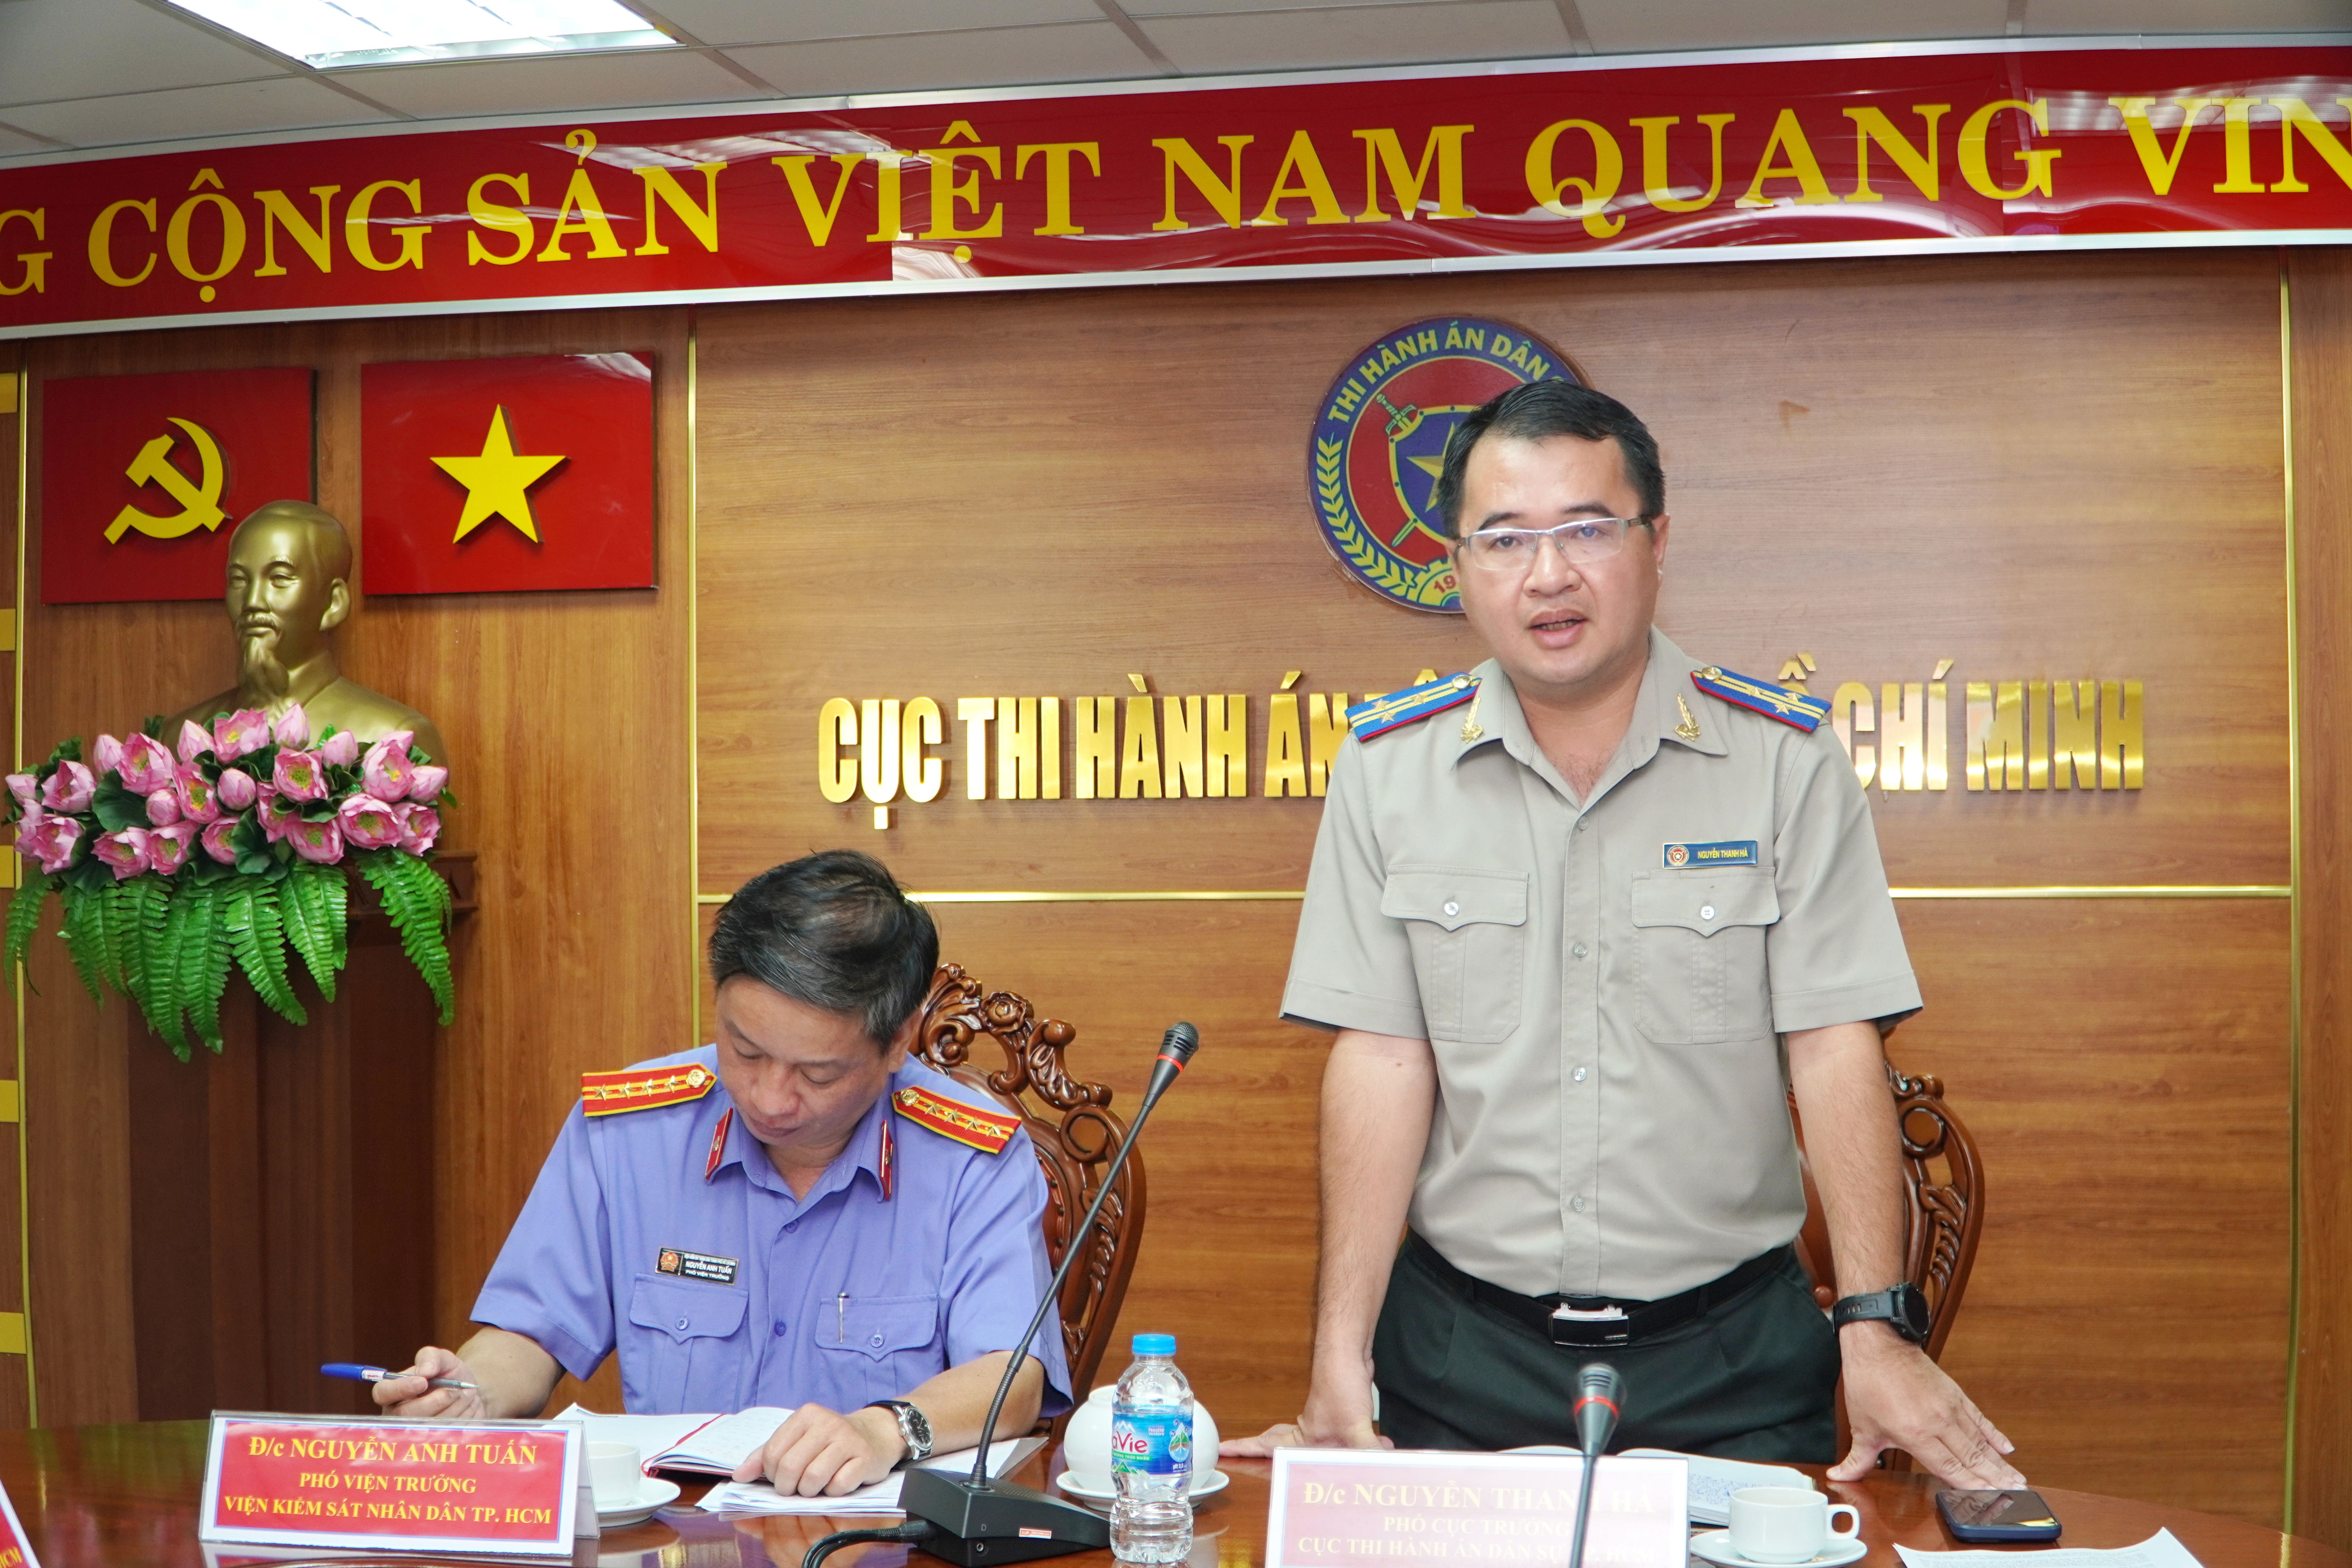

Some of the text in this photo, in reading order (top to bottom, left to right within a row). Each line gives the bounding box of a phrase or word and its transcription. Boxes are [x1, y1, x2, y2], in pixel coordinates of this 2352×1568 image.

[88, 169, 432, 303] CỘNG
[467, 129, 727, 266] SẢN
[771, 120, 1100, 263] VIỆT
[1152, 125, 1475, 230] NAM
[1525, 99, 2062, 238] QUANG
[2109, 96, 2352, 195] VIN
[1328, 321, 1551, 423] THI HÀNH ÁN DÂN
[1832, 659, 2143, 791] CHÍ MINH
[818, 670, 1348, 831] CỤC THI HÀNH ÁN
[1720, 849, 1739, 858] THANH
[1740, 847, 1748, 857] HÀ
[706, 1264, 718, 1272] ANH
[249, 1436, 537, 1465] Đ/c NGUYỄN ANH TUẤN
[299, 1470, 477, 1494] PHÓ VIỆN TRƯỞNG
[1303, 1483, 1345, 1505] Đ/c
[1354, 1479, 1481, 1508] NGUYỄN
[1611, 1484, 1655, 1513] HÀ
[224, 1494, 552, 1524] VIỆN KIỂM SÁT NHÂN DÂN TP. HCM
[1383, 1514, 1570, 1538] PHÓ CỤC TRƯỞNG
[1298, 1537, 1341, 1557] CỤC
[1347, 1539, 1381, 1555] THI
[1388, 1536, 1448, 1557] HÀNH
[1455, 1537, 1481, 1559] ÁN
[1489, 1539, 1531, 1560] DÂN
